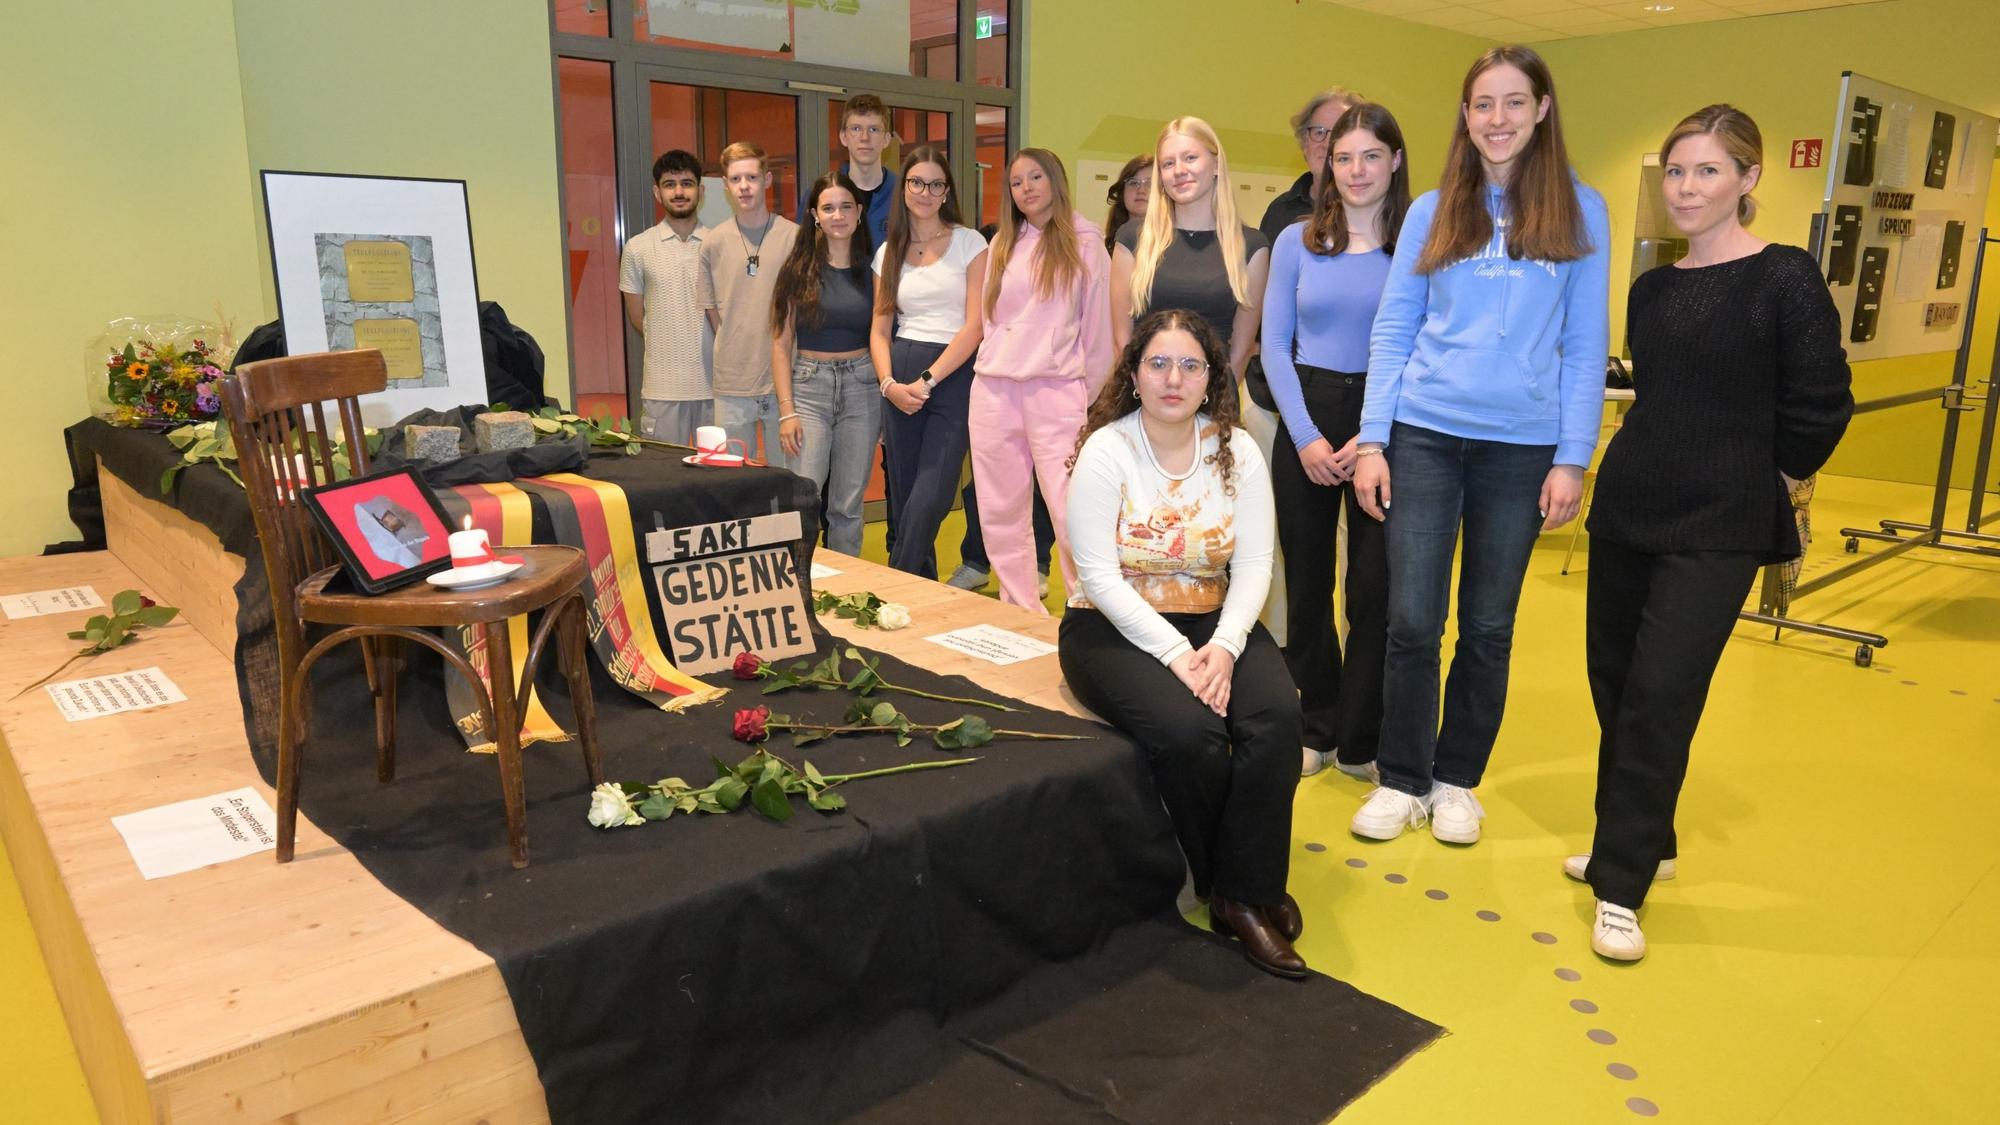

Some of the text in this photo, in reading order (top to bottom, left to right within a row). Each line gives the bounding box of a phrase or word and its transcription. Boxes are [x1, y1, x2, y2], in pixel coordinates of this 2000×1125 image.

[1888, 192, 1915, 210] ZEUGE
[1884, 217, 1912, 234] SPRICHT
[662, 551, 796, 605] GEDENK-
[673, 604, 802, 663] STÄTTE
[211, 806, 226, 816] das
[236, 806, 267, 838] Stolperstein
